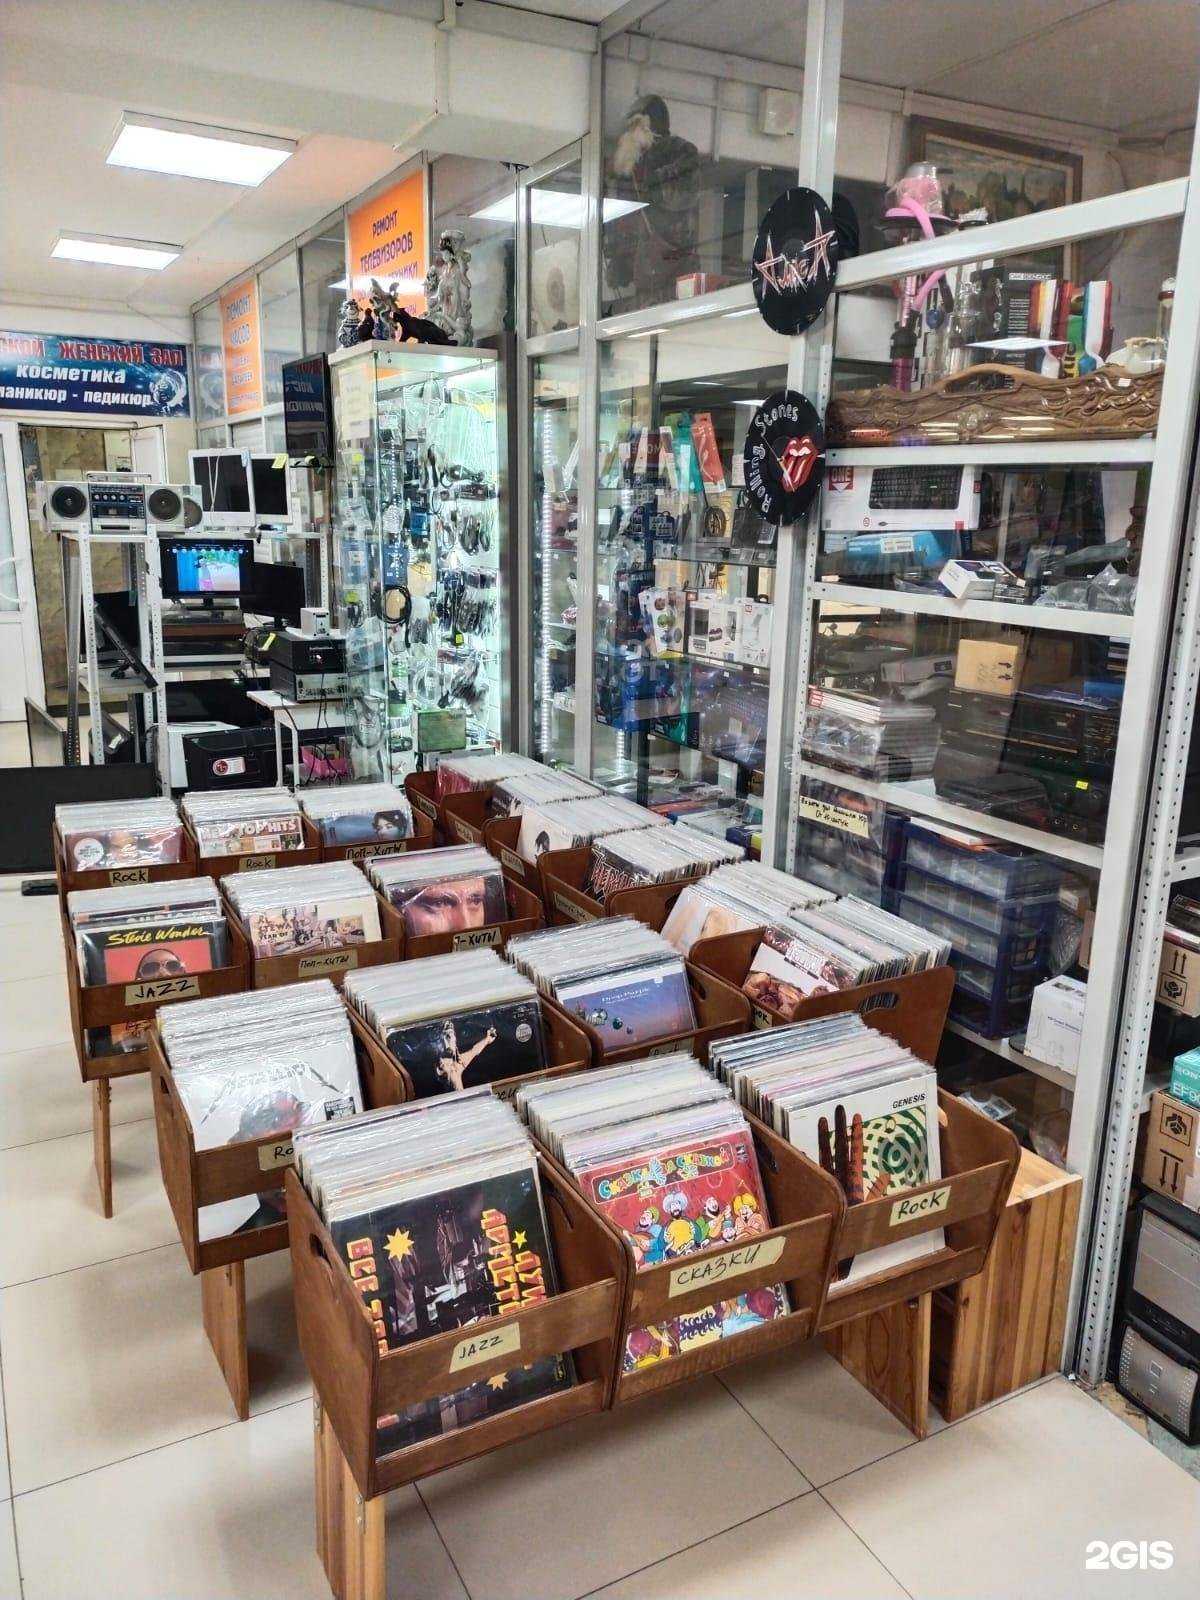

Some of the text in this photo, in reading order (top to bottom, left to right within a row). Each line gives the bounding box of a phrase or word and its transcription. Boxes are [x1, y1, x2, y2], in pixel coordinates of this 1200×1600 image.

[371, 209, 398, 239] РЕМОНТ
[360, 231, 413, 273] ТЕЛЕВИЗОРОВ
[60, 341, 145, 364] ЖЕНСКИЙ
[151, 348, 183, 367] ЗАЛ
[83, 391, 151, 406] педикюр
[749, 403, 799, 513] Rolling Stones
[104, 924, 211, 946] Stevie Wonder
[135, 979, 195, 998] JAZZ
[892, 1093, 926, 1109] GENESIS
[677, 1244, 761, 1284] СКАЗКИ
[459, 1335, 504, 1359] JAZZ
